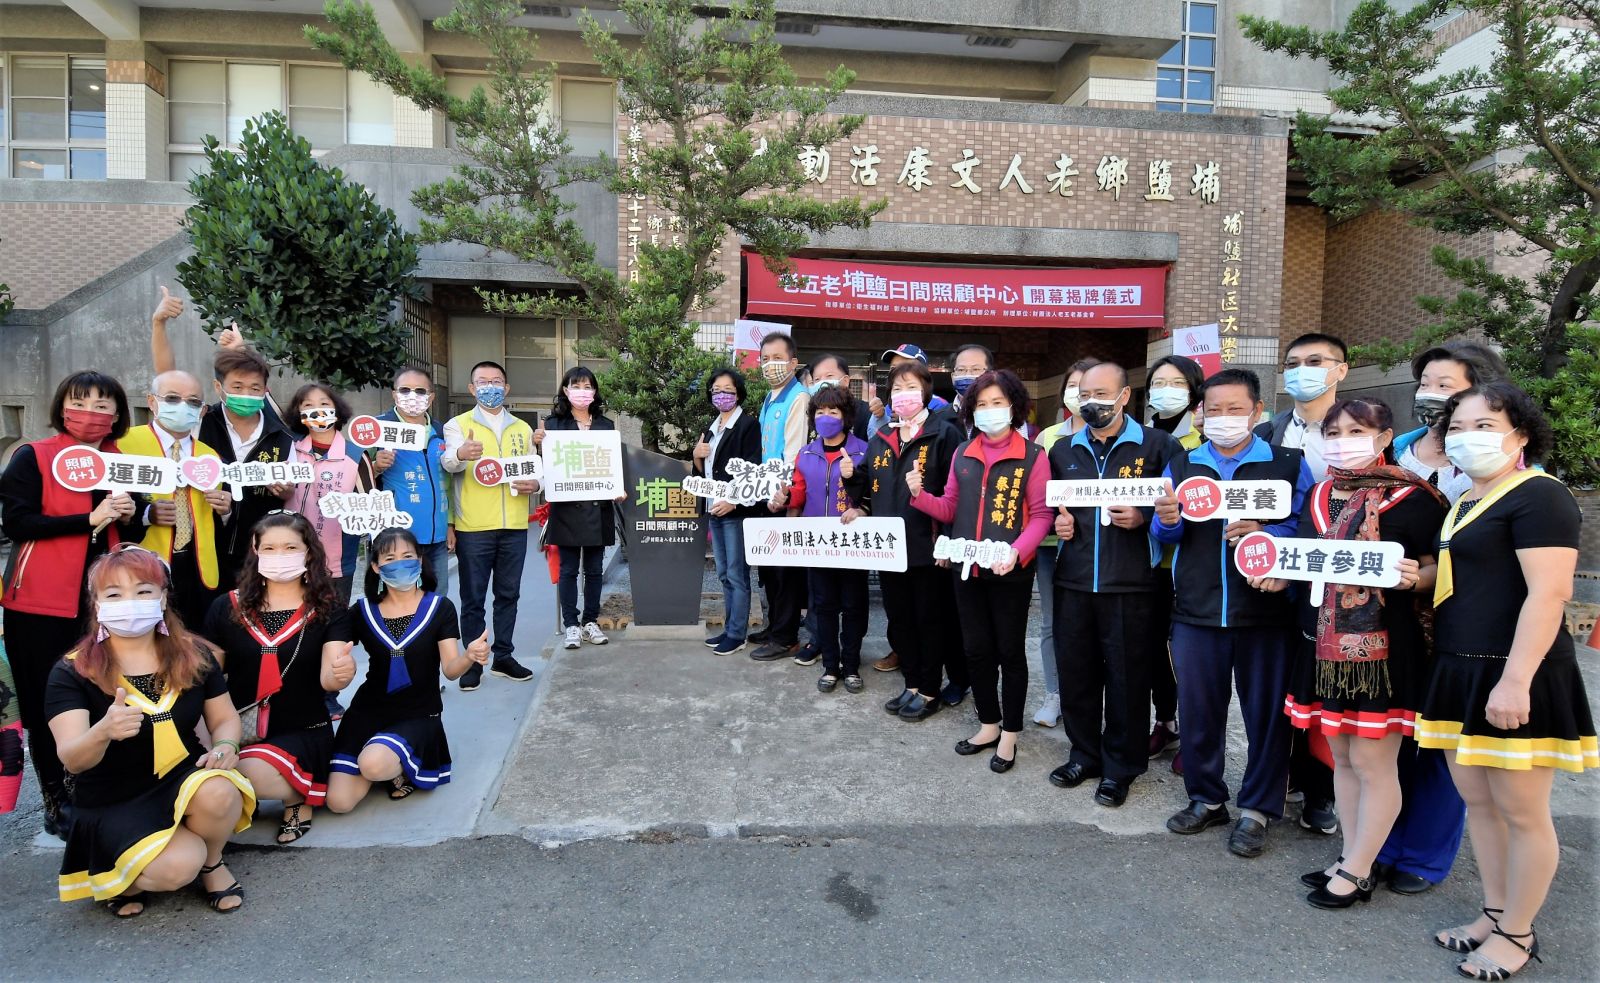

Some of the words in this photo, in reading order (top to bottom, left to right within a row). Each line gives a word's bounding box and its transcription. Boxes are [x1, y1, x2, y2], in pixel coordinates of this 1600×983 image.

[692, 139, 1222, 204] 埔鹽鄉老人文康活動
[1030, 289, 1135, 304] 開幕揭牌儀式
[357, 431, 377, 441] 4+1
[383, 426, 417, 445] 習慣
[64, 456, 95, 471] 照顧
[552, 440, 614, 478] 埔鹽
[68, 469, 98, 482] 4+1
[108, 463, 163, 487] 運動
[483, 470, 499, 481] 4+1
[504, 461, 535, 477] 健康
[554, 481, 614, 492] 日間照顧中心
[1184, 485, 1212, 499] 照顧
[325, 494, 394, 514] 我照顧
[635, 477, 699, 518] 埔鹽
[1188, 498, 1215, 512] 4+1
[1225, 488, 1277, 510] 營養
[344, 514, 411, 532] 你放心
[635, 521, 699, 531] 日間照顧中心
[782, 530, 897, 550] 財團法人老五老基金會
[751, 545, 770, 554] OFO
[782, 548, 798, 556] OLD
[845, 550, 895, 559] FOUNDATION
[1244, 542, 1268, 556] 照顧
[1246, 556, 1270, 571] 4+1
[1278, 547, 1384, 577] 社會參與
